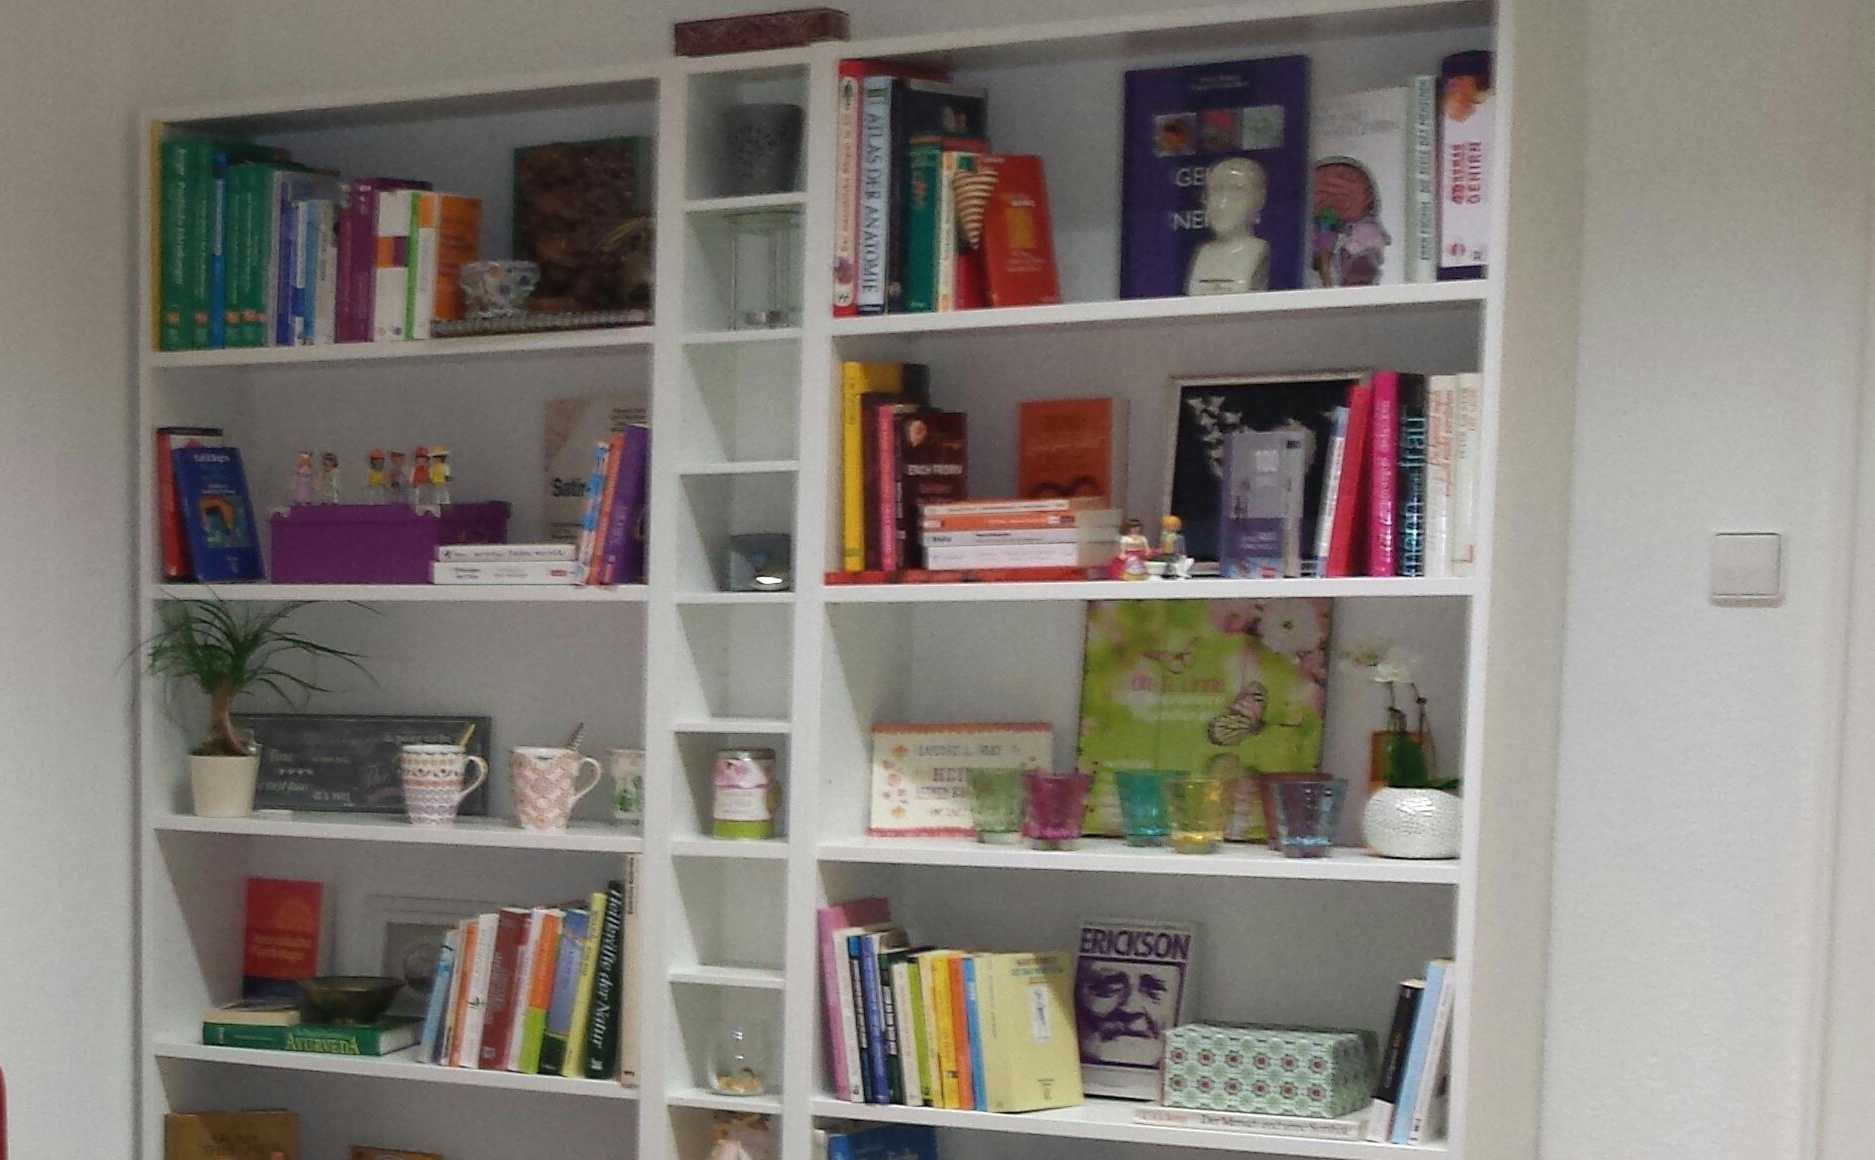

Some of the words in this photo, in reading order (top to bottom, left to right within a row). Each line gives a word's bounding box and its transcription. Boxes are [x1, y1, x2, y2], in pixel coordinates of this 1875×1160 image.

[866, 112, 881, 166] ATLAS
[865, 169, 878, 203] DER
[861, 206, 879, 294] ANATOMIE
[1079, 927, 1191, 959] ERICKSON
[592, 1002, 611, 1049] Natur
